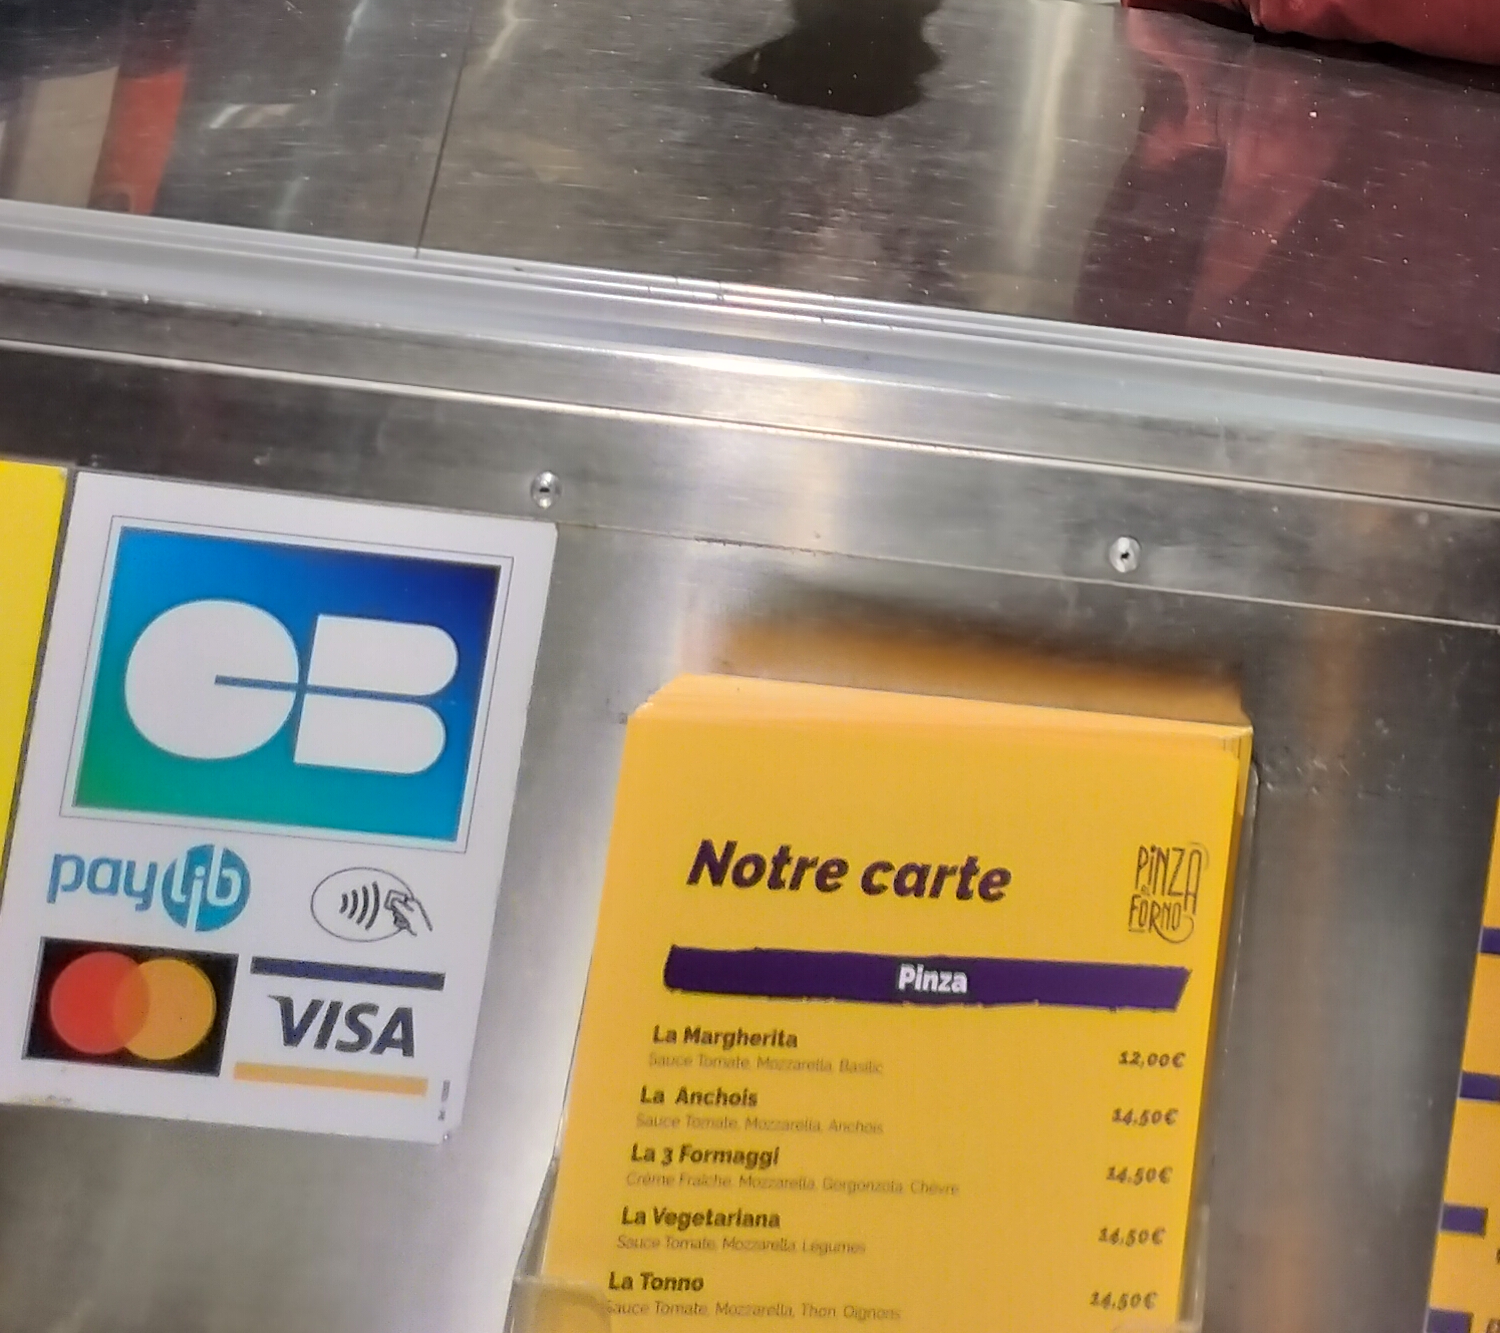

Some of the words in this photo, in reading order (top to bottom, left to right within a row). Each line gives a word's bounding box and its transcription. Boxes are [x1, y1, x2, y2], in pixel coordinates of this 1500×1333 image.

[123, 598, 460, 775] CB
[686, 839, 849, 894] Notre
[860, 855, 1013, 904] carte
[46, 843, 252, 933] paylib
[898, 965, 968, 994] Pinza
[267, 992, 417, 1058] VISA
[652, 1024, 677, 1045] La
[683, 1025, 798, 1051] Margherita
[640, 1085, 665, 1105] La
[675, 1086, 758, 1108] Anchois
[630, 1143, 656, 1163] La
[661, 1148, 672, 1166] 3
[679, 1144, 780, 1170] Formaggi
[621, 1205, 647, 1227] La
[652, 1206, 781, 1231] Vegetariana
[608, 1270, 633, 1291] La
[640, 1271, 705, 1292] Tonno
